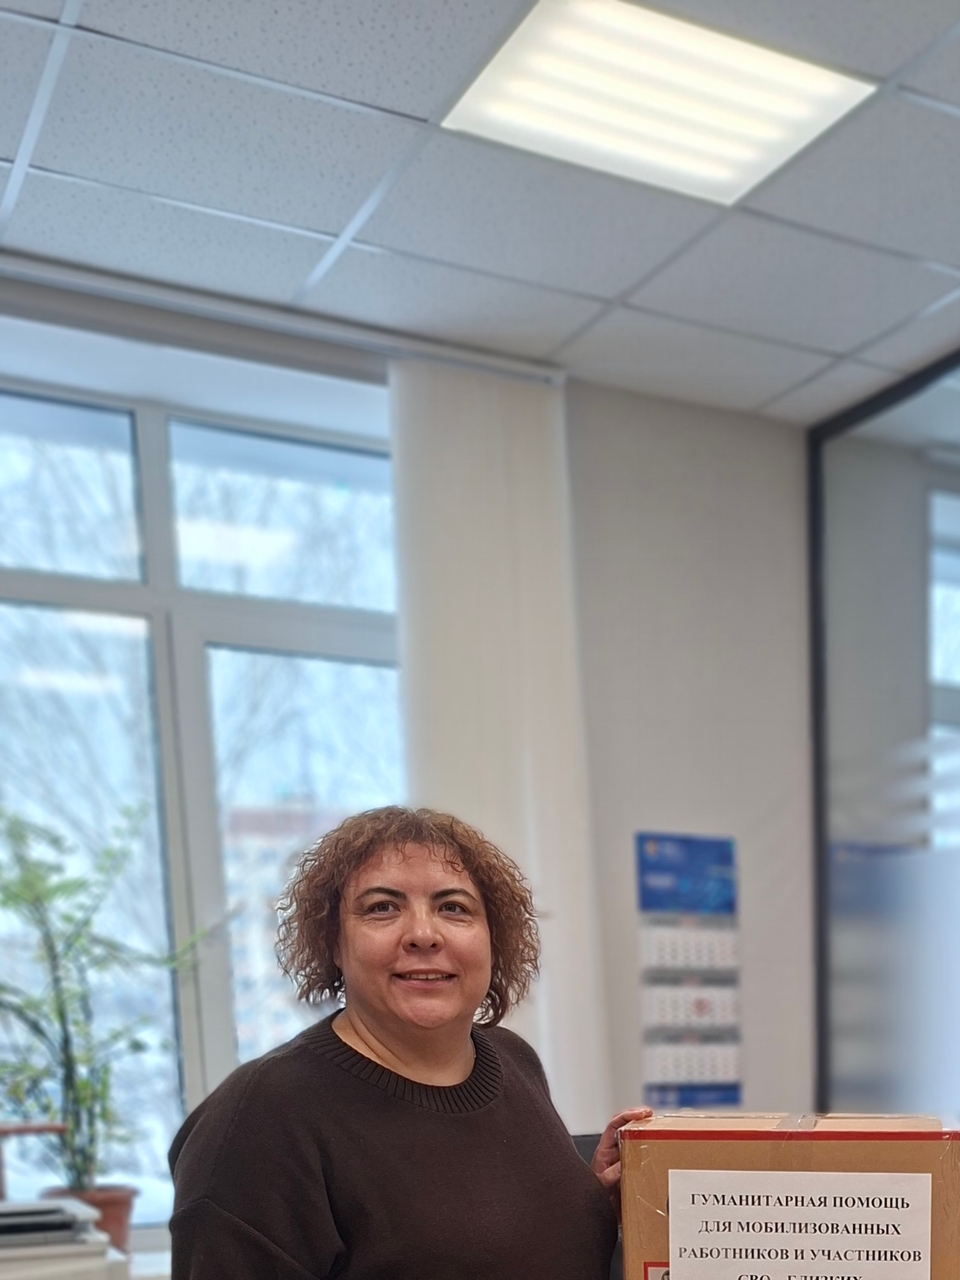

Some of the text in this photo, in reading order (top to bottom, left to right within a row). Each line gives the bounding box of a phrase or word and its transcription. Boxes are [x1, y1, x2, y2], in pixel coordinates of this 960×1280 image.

[690, 1193, 910, 1211] ГУМАНИТАРНАЯ ПОМОЩЬ
[698, 1220, 902, 1236] ДЛЯ МОБИЛИЗОВАННЫХ
[678, 1246, 923, 1263] РАБОТНИКОВ И УЧАСТНИКОВ
